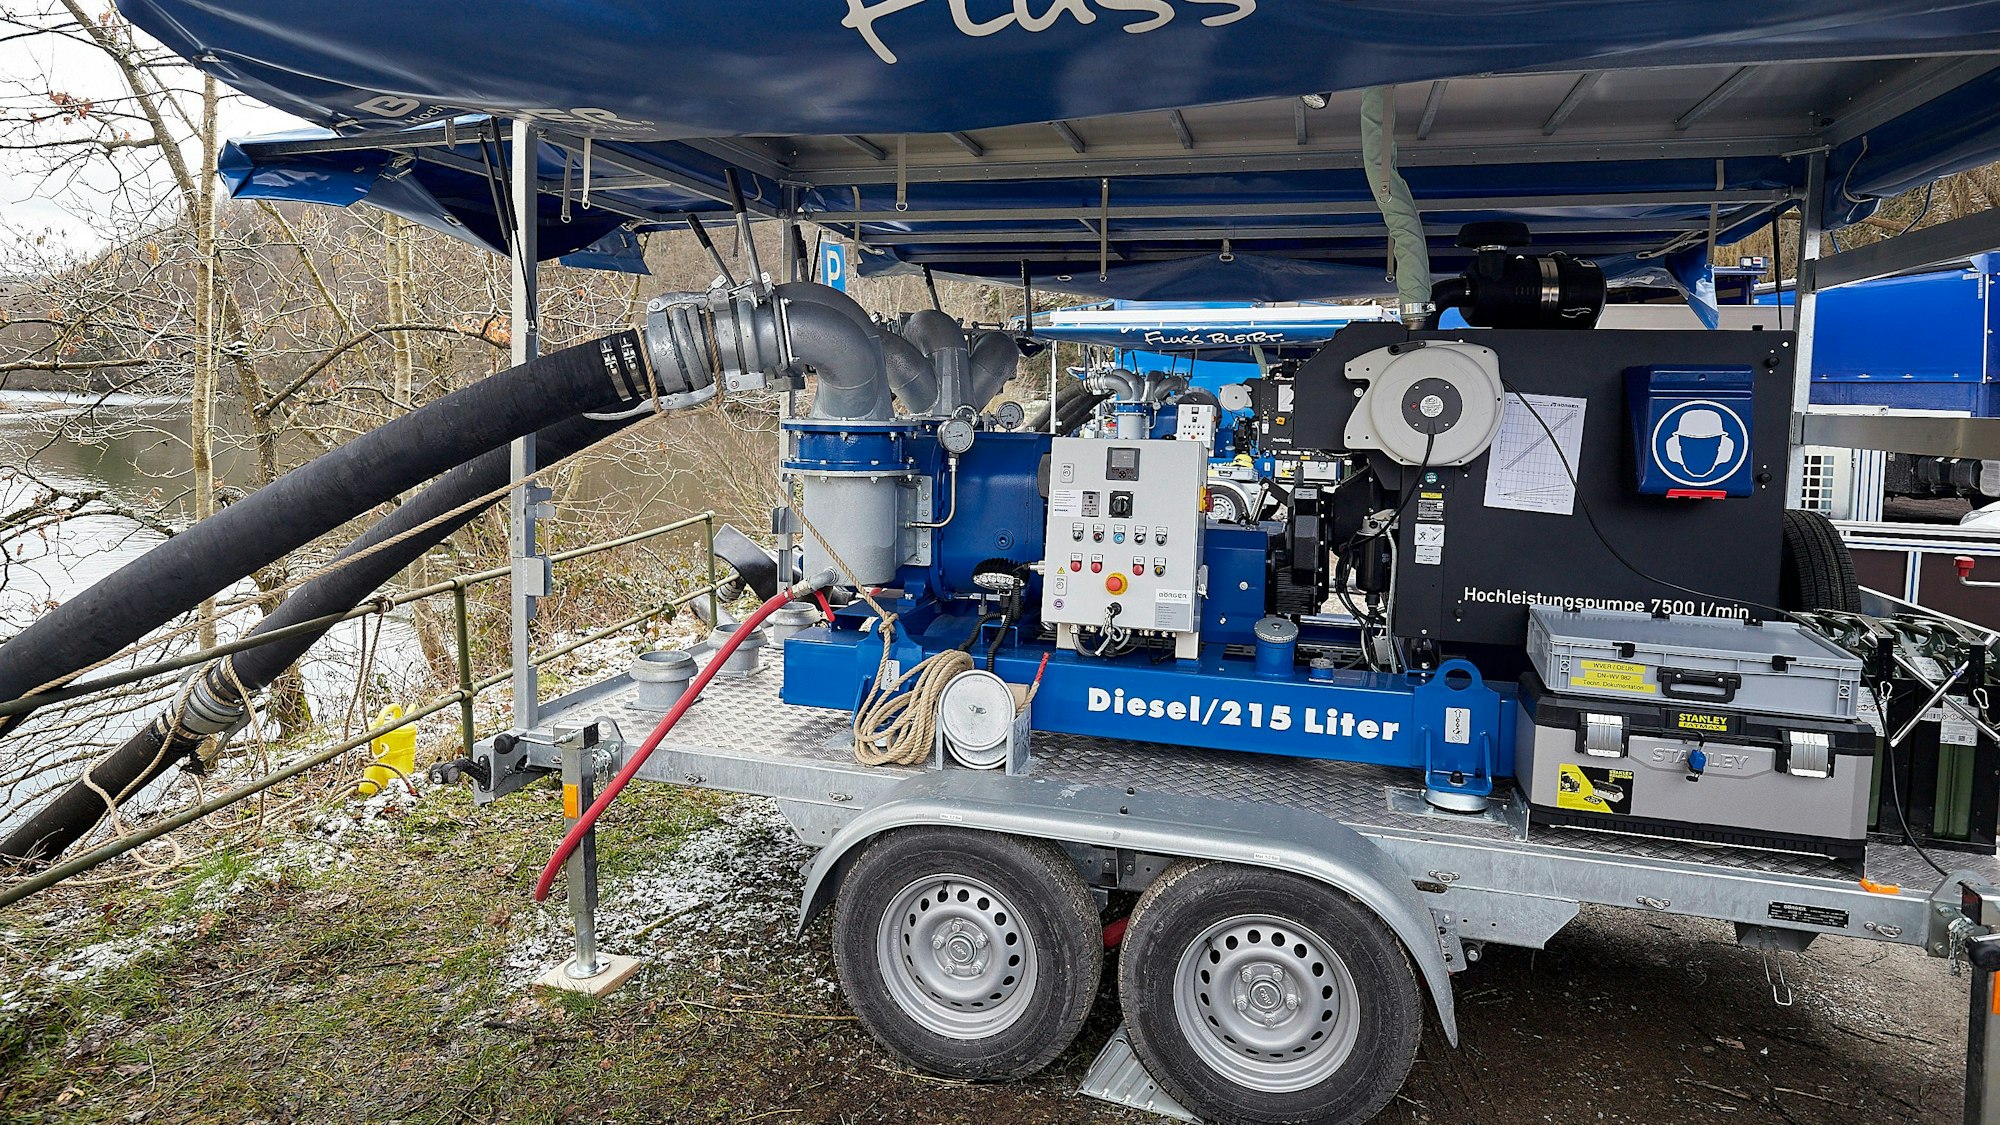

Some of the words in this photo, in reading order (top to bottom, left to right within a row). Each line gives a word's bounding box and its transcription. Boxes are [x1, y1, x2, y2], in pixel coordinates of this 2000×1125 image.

[827, 250, 841, 287] P
[1463, 586, 1645, 613] Hochleistungspumpe
[1651, 598, 1695, 616] 7500
[1602, 681, 1644, 690] Dokumentation
[1087, 687, 1292, 731] Diesel/215
[1304, 707, 1400, 741] Liter
[1679, 713, 1728, 725] STANLEY
[1683, 722, 1721, 730] FATMAX
[1652, 747, 1749, 769] STALEY
